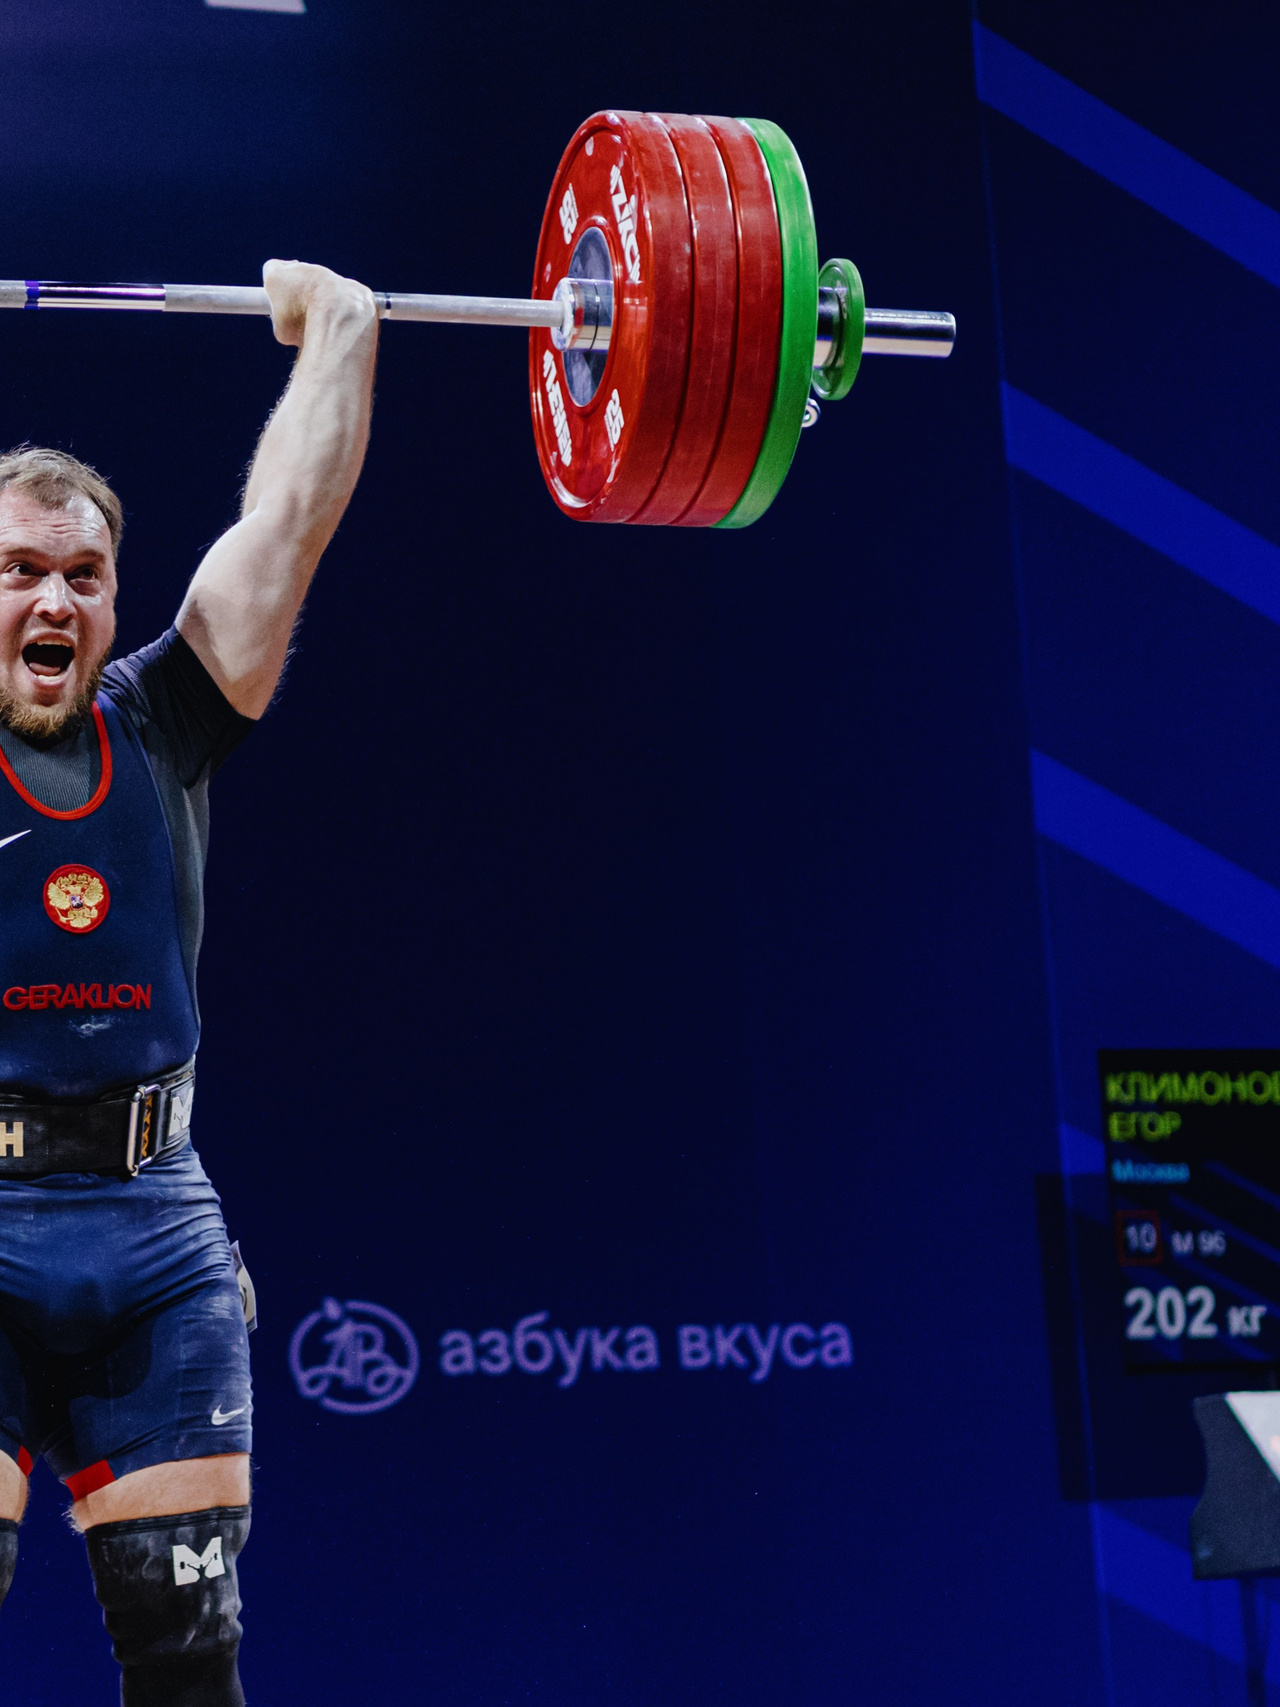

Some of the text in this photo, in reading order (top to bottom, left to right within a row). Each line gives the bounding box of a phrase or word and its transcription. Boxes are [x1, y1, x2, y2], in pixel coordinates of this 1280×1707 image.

[3, 982, 151, 1011] GERAKLION
[1109, 1111, 1181, 1141] ЕГОР
[1126, 1222, 1157, 1253] 10
[1124, 1286, 1218, 1340] 202
[439, 1311, 853, 1388] азбука вкуса
